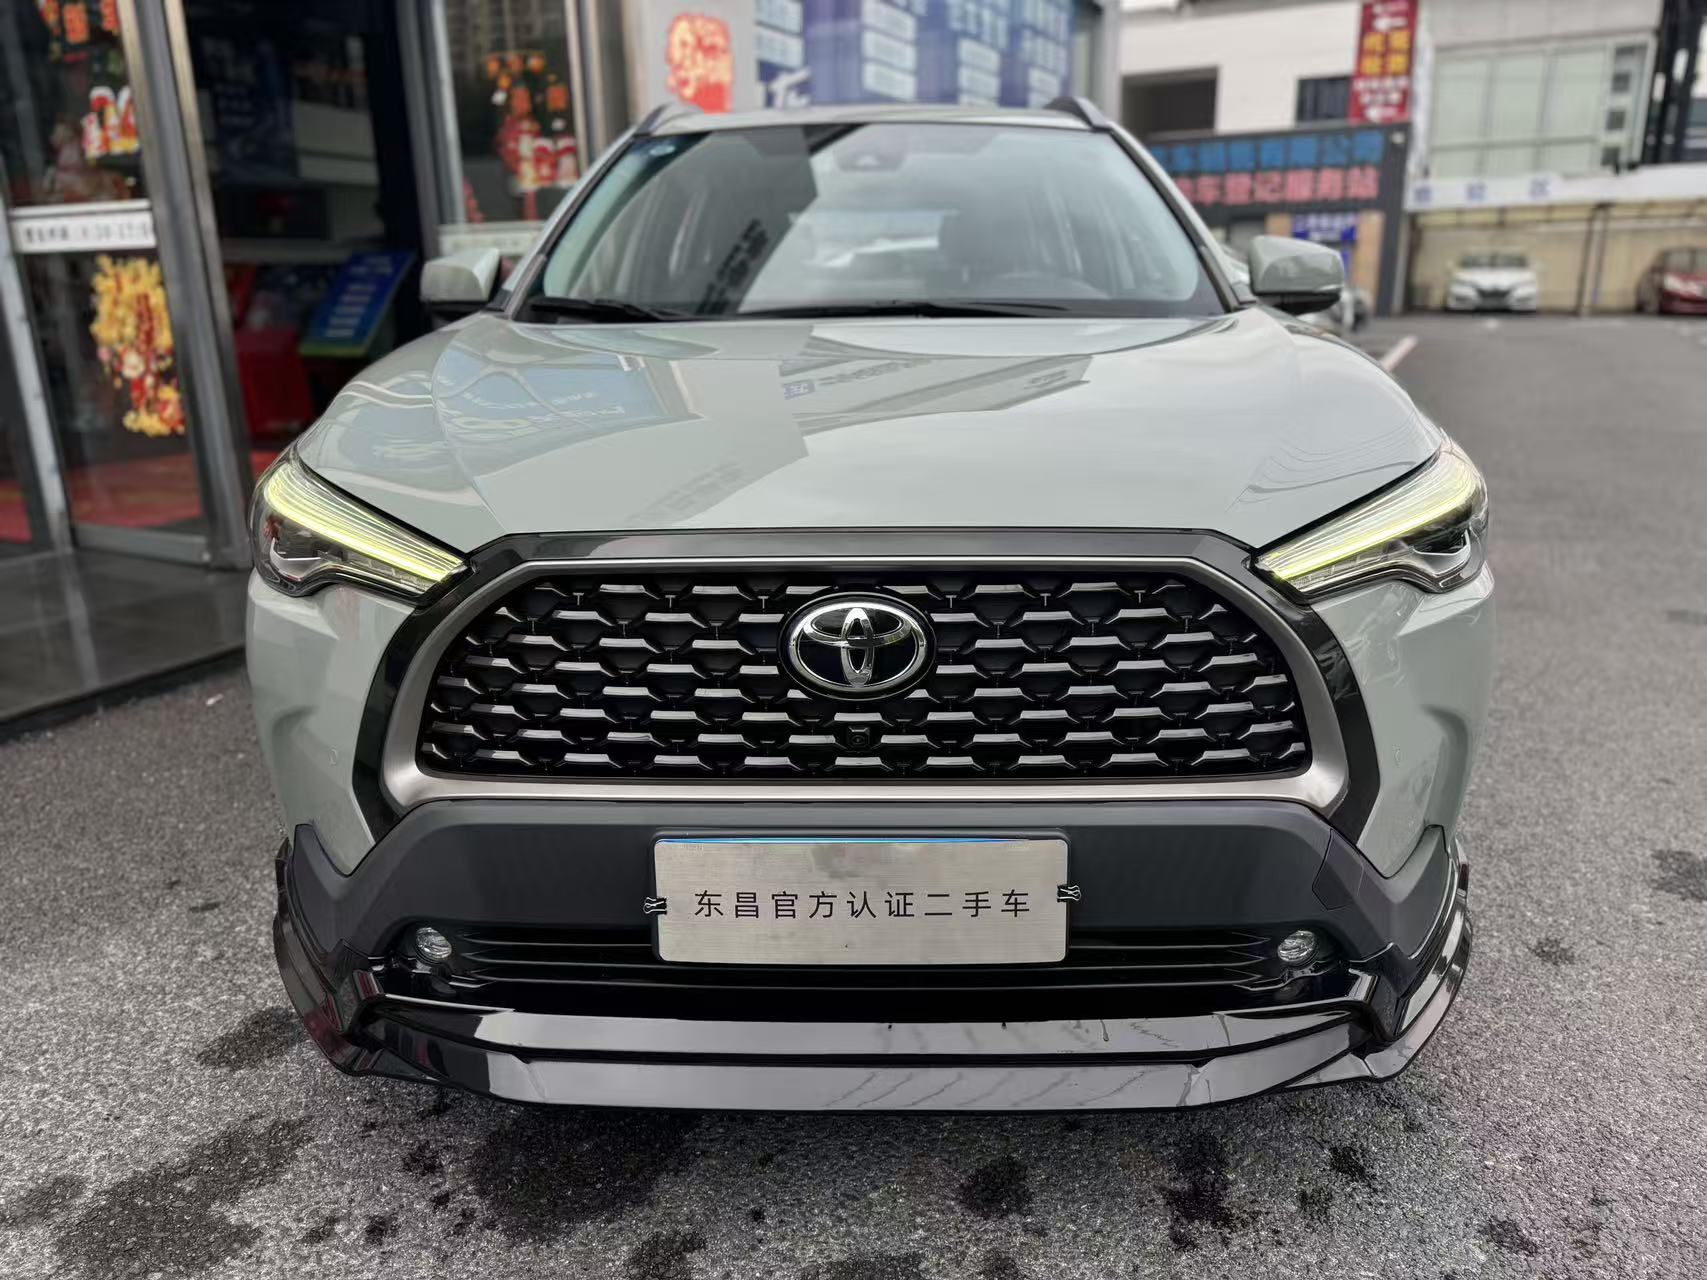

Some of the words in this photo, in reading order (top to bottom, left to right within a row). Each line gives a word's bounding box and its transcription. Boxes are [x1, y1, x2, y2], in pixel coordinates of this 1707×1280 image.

[694, 889, 1031, 919] 东昌官方认证二手车
